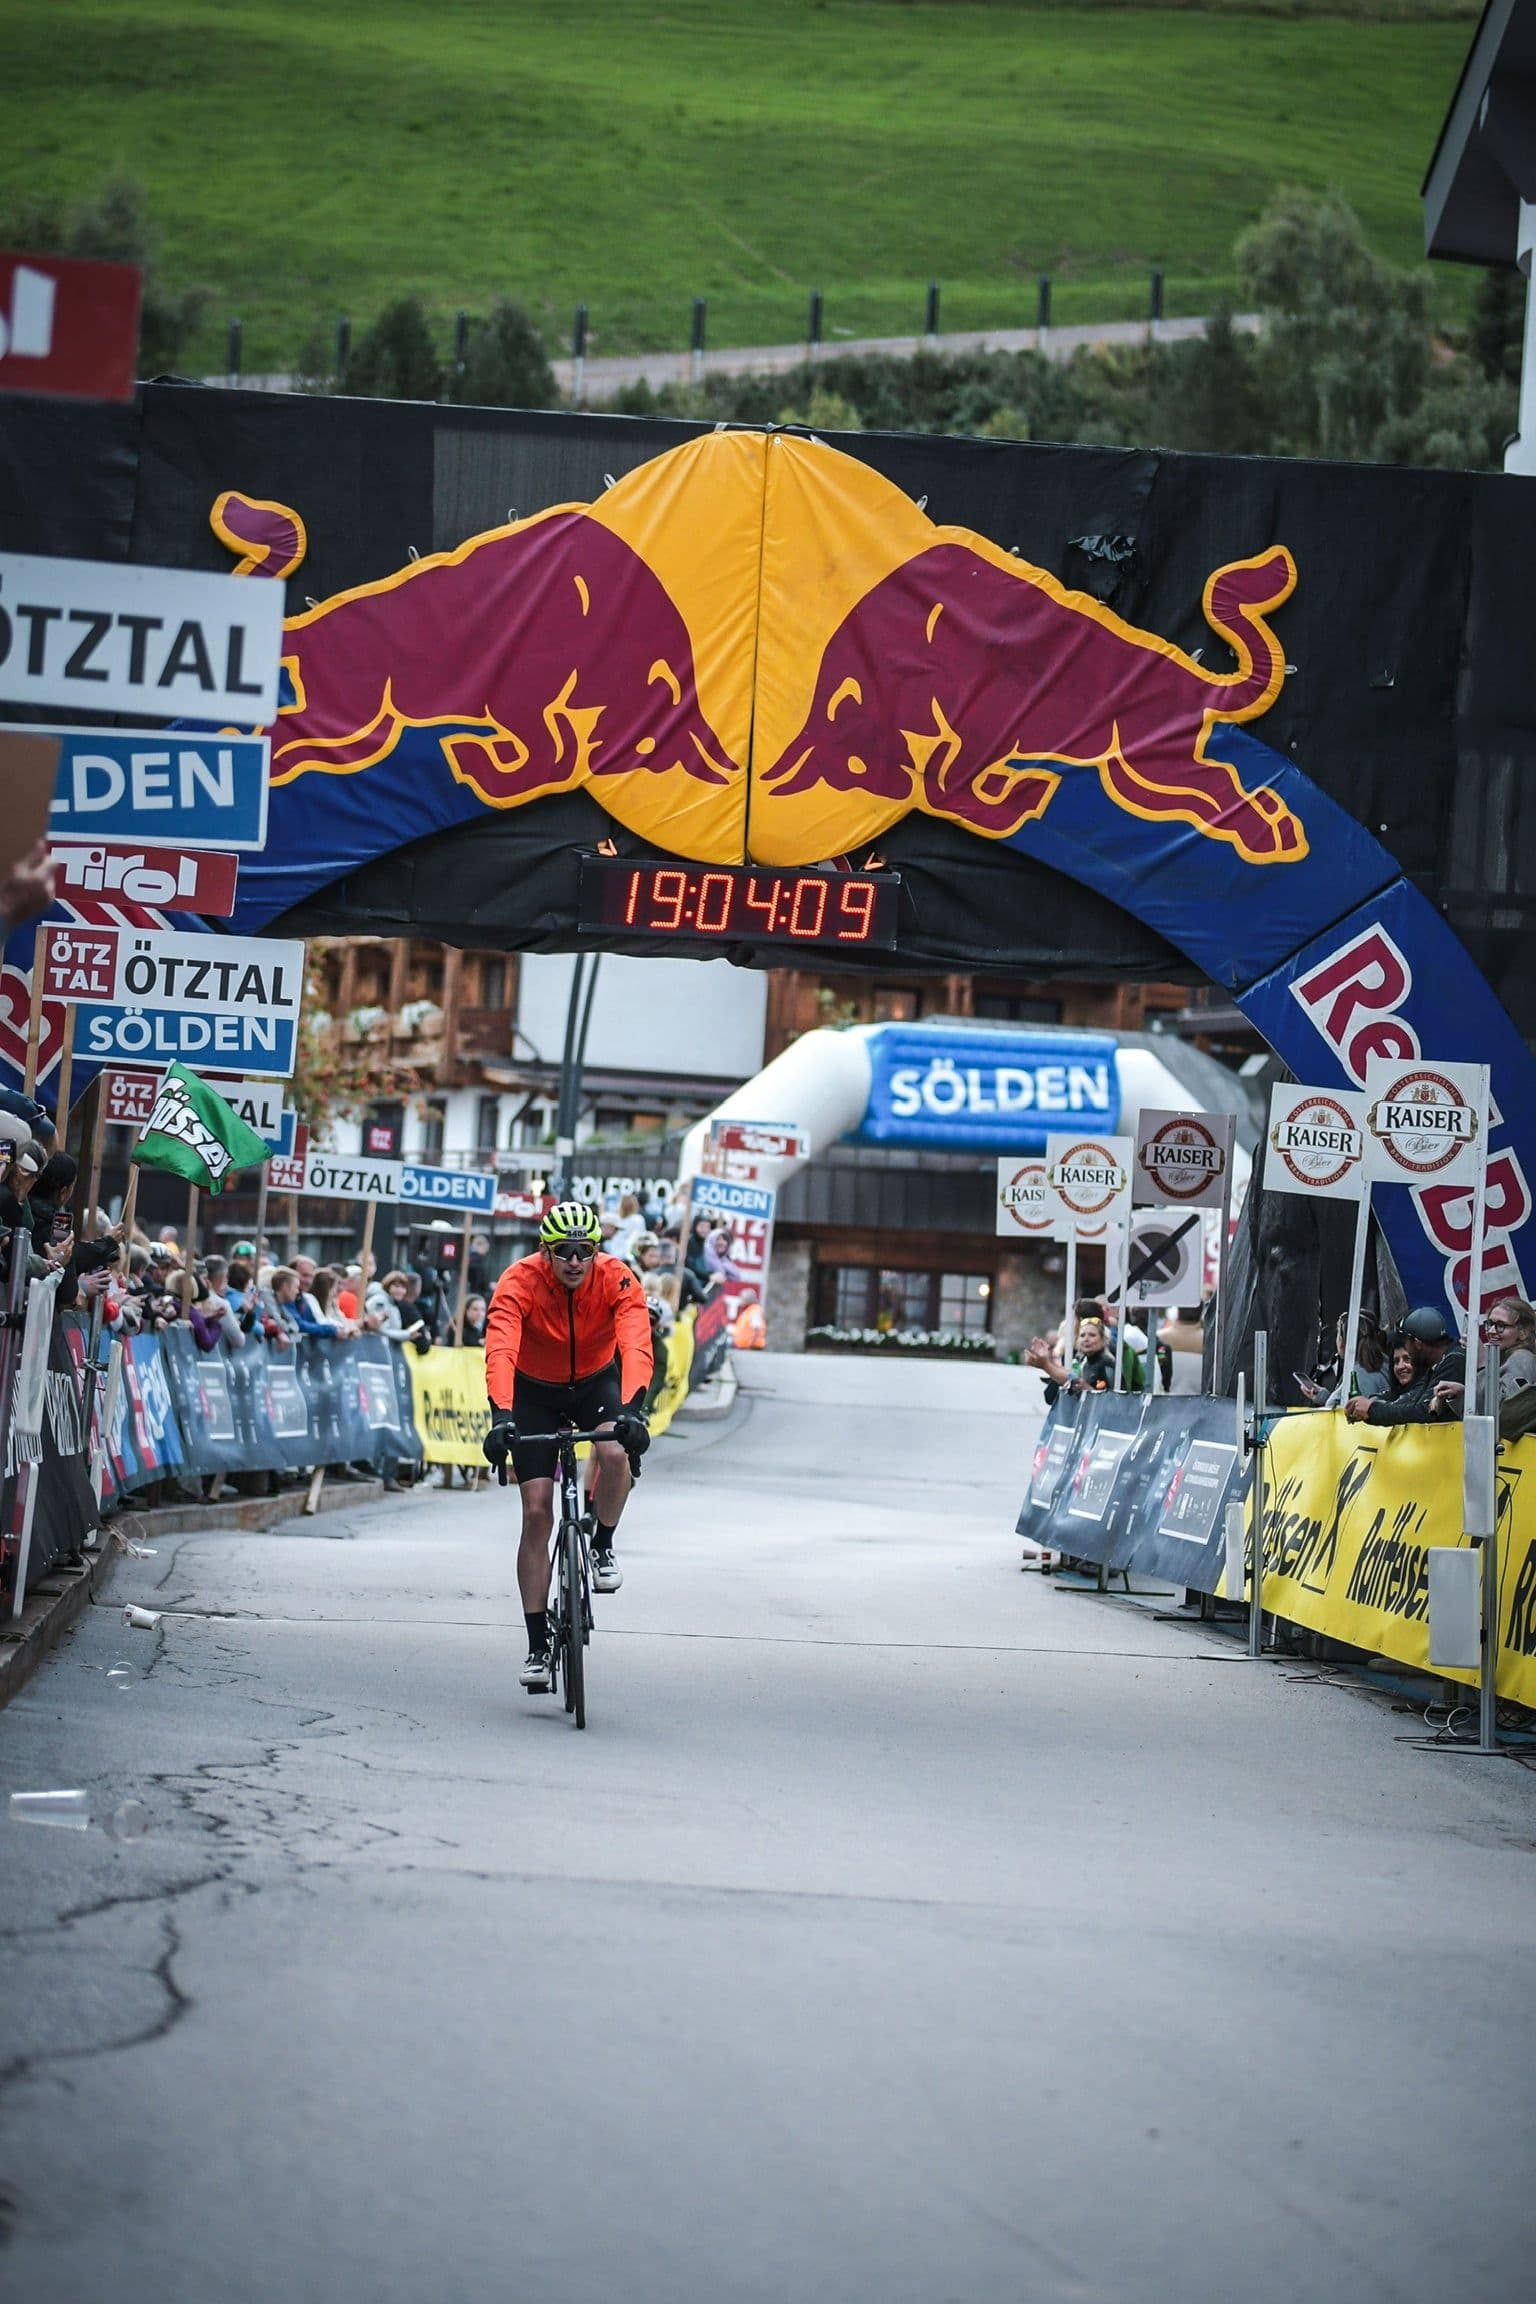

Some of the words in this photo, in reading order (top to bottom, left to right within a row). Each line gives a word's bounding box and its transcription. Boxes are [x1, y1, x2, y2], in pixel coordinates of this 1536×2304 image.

[0, 574, 263, 695] TZTAL
[625, 871, 875, 939] 19:04:09
[51, 932, 111, 966] ÖTZ
[50, 967, 108, 992] TAL
[125, 940, 293, 1006] ÖTZTAL
[89, 1007, 276, 1052] SÖLDEN
[112, 1076, 152, 1099] ÖTZ
[889, 1057, 1110, 1117] SÖLDEN
[1385, 1105, 1462, 1132] KAISER
[1286, 1126, 1353, 1153] KAISER
[1153, 1146, 1214, 1168] KAISER
[270, 1171, 302, 1187] TAL
[310, 1159, 396, 1196] ÖTZTAL
[1060, 1167, 1115, 1185] KAISER
[697, 1183, 769, 1211] SÖLDEN
[1011, 1188, 1045, 1202] KAIS
